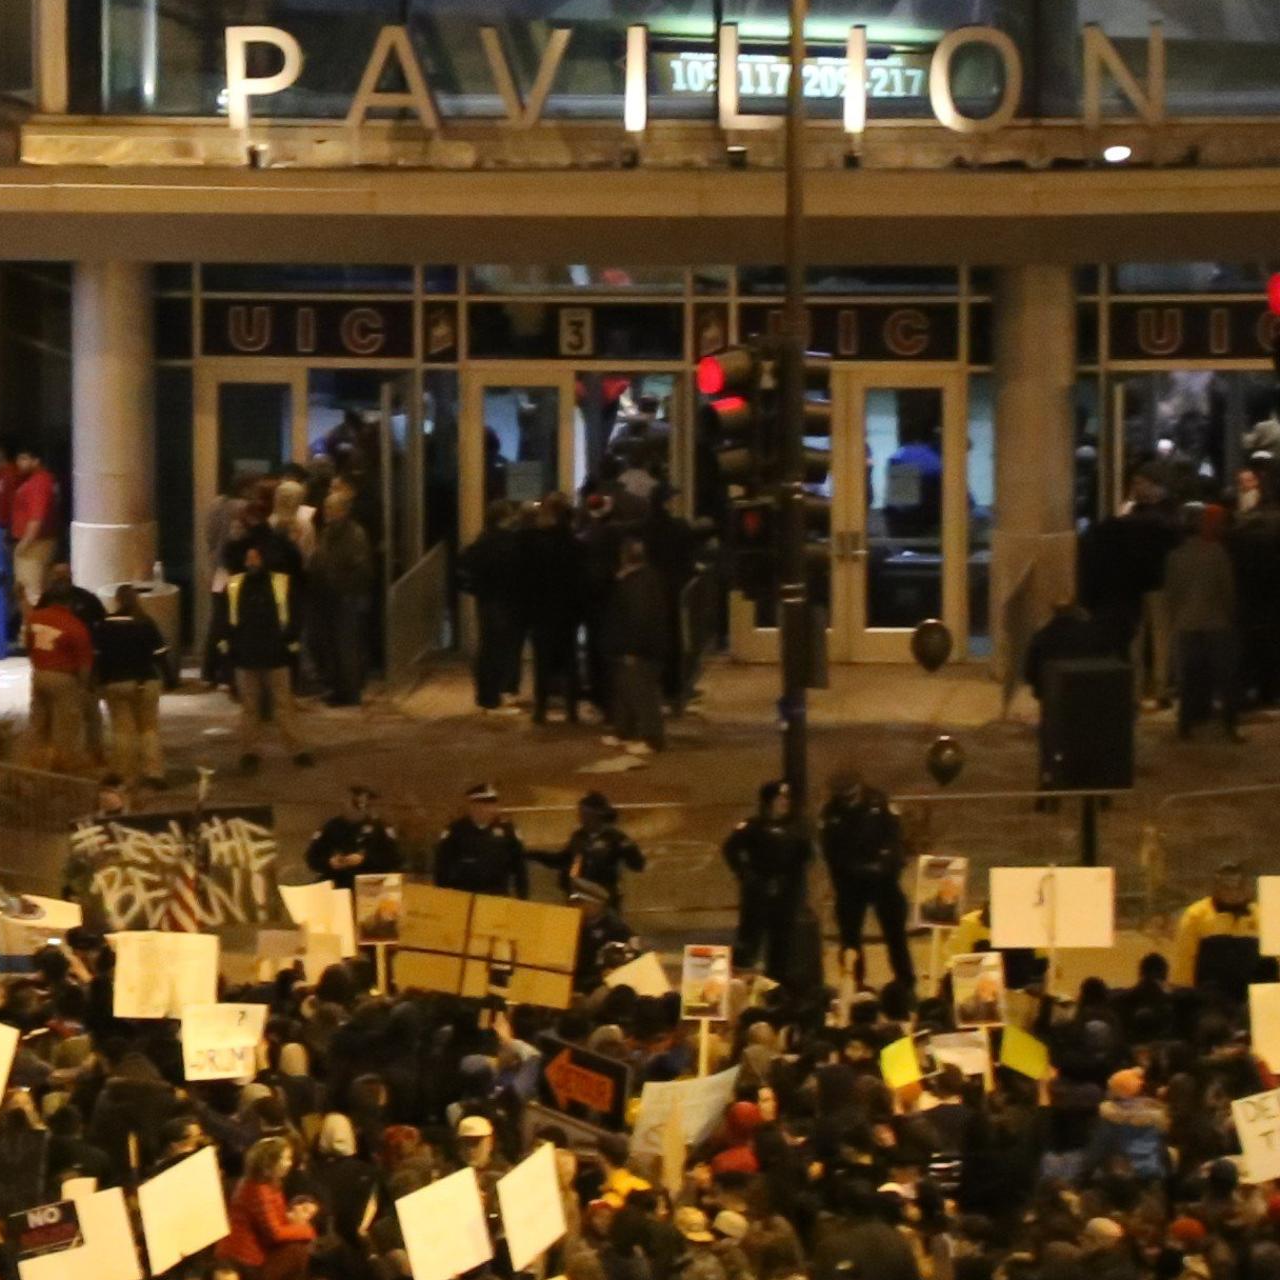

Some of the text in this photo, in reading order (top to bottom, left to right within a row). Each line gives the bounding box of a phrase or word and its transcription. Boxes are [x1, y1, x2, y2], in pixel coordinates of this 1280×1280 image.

[224, 20, 1165, 135] PAVILION
[228, 306, 386, 354] UIC
[566, 317, 585, 352] 3
[27, 1206, 62, 1229] NO
